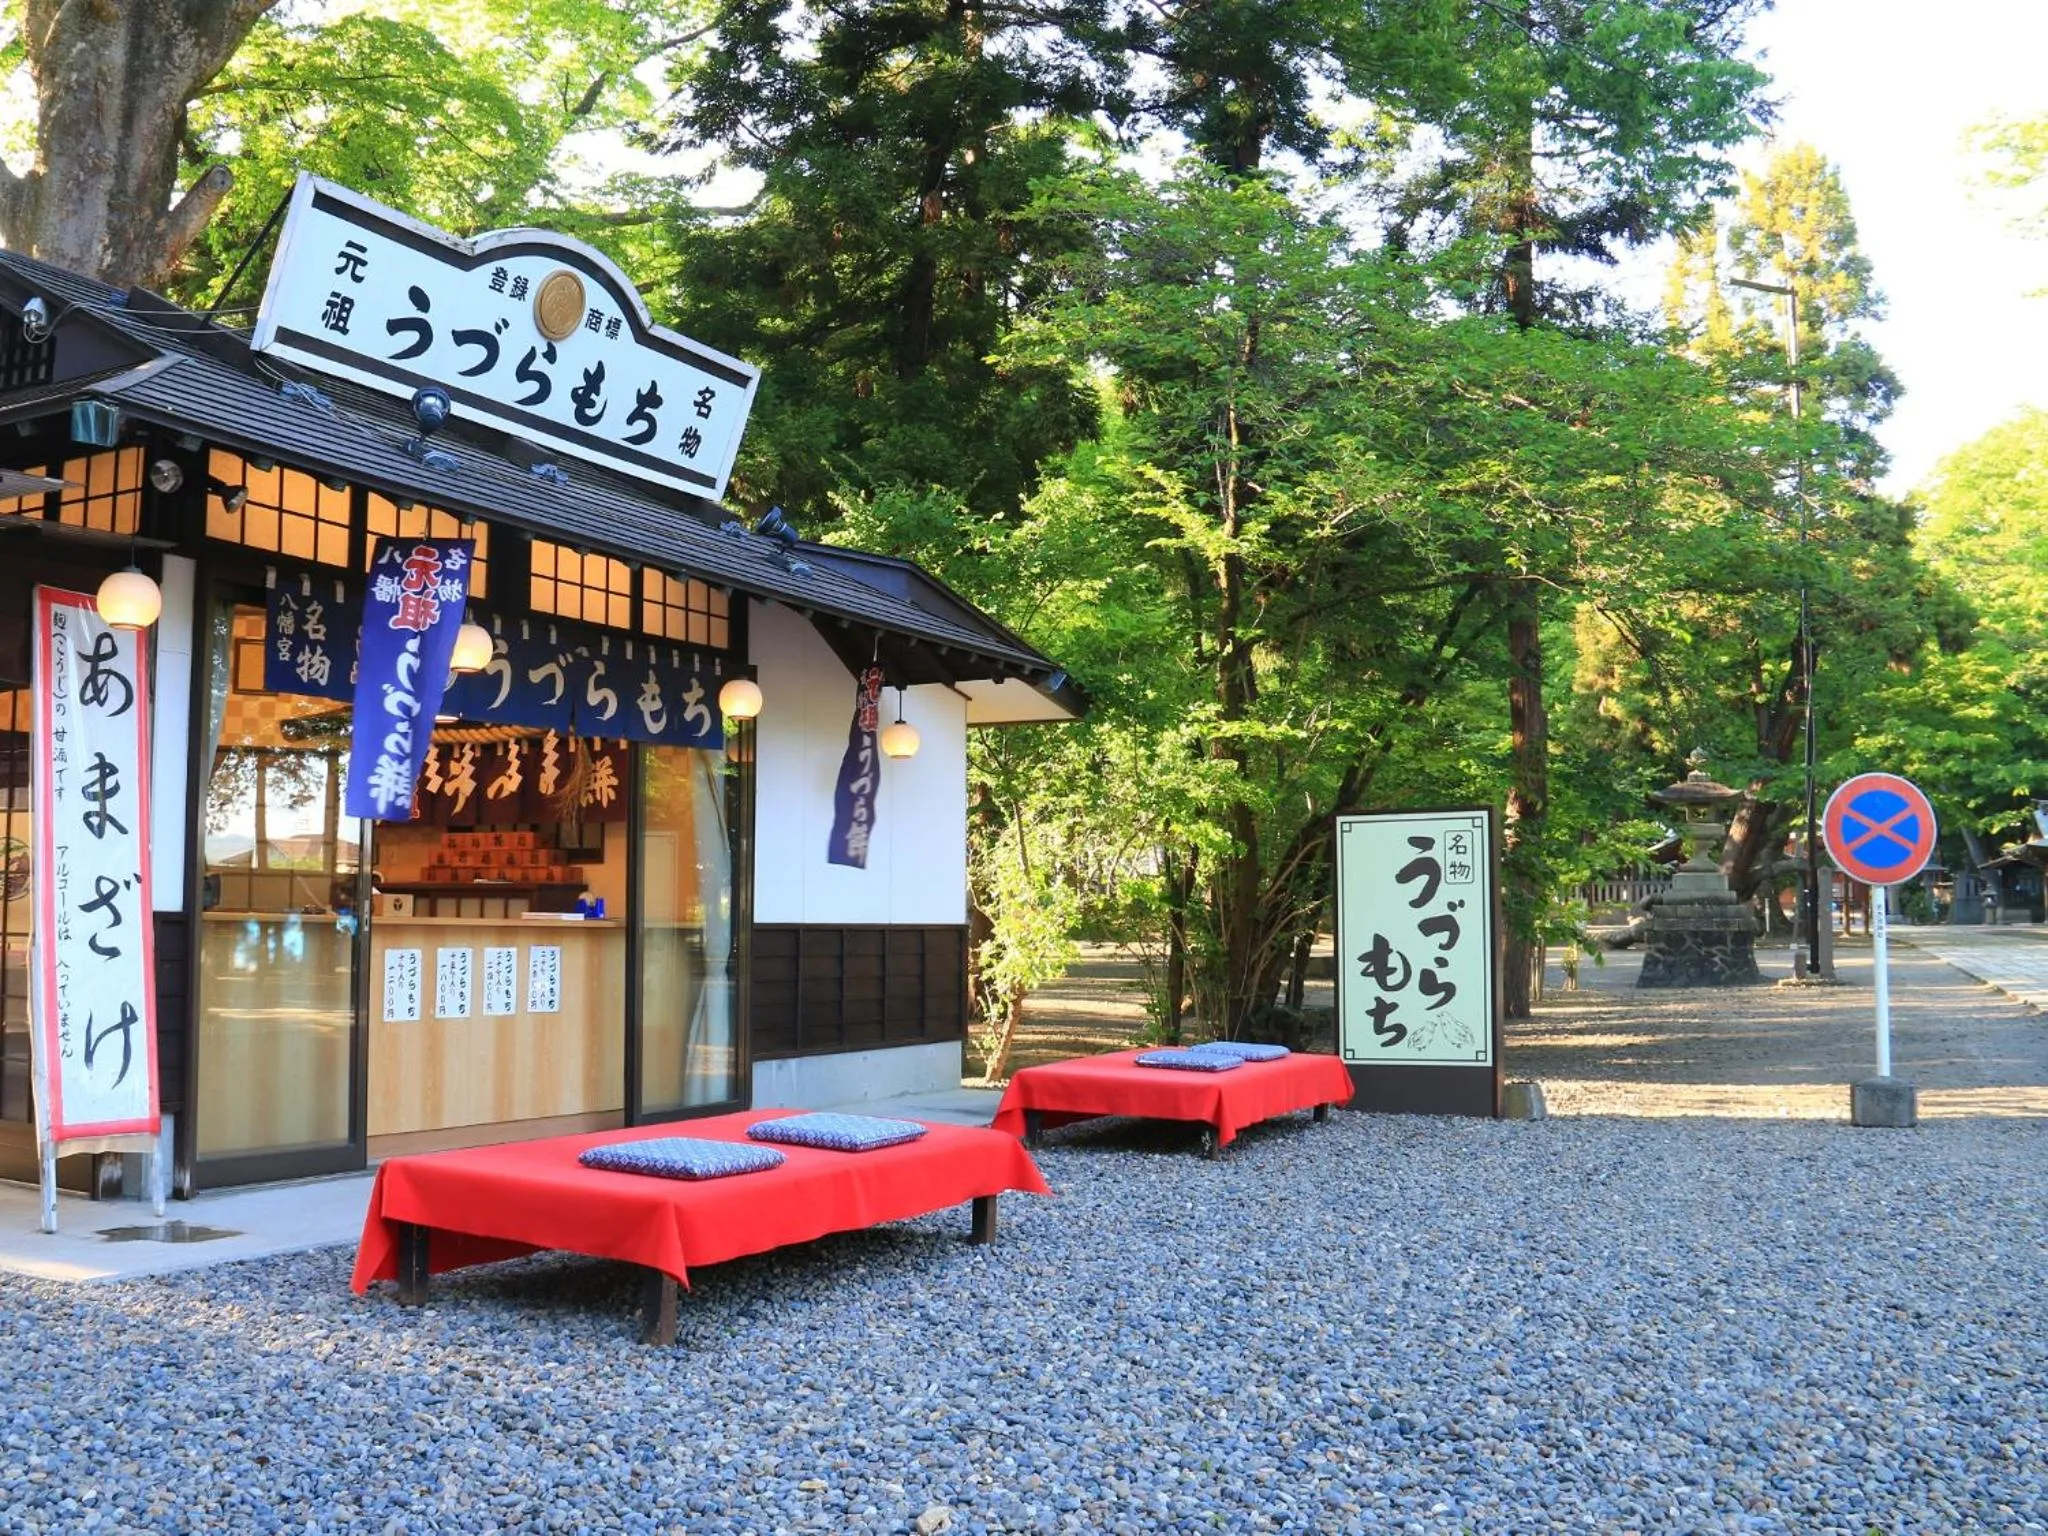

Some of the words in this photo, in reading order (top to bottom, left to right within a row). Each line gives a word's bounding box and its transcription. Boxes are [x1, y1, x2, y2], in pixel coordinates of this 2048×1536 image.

[321, 240, 368, 336] 元祖
[489, 266, 530, 303] 登録
[584, 307, 623, 341] 商標
[386, 285, 664, 446] うづらもち
[678, 386, 717, 459] 名物
[276, 592, 299, 661] 八幡宮
[296, 600, 331, 686] 名物
[485, 639, 713, 738] うづらもち
[77, 631, 142, 1091] あまざけ
[1448, 834, 1471, 880] 名物
[1395, 836, 1466, 1011] うづら
[1357, 933, 1413, 1048] もち
